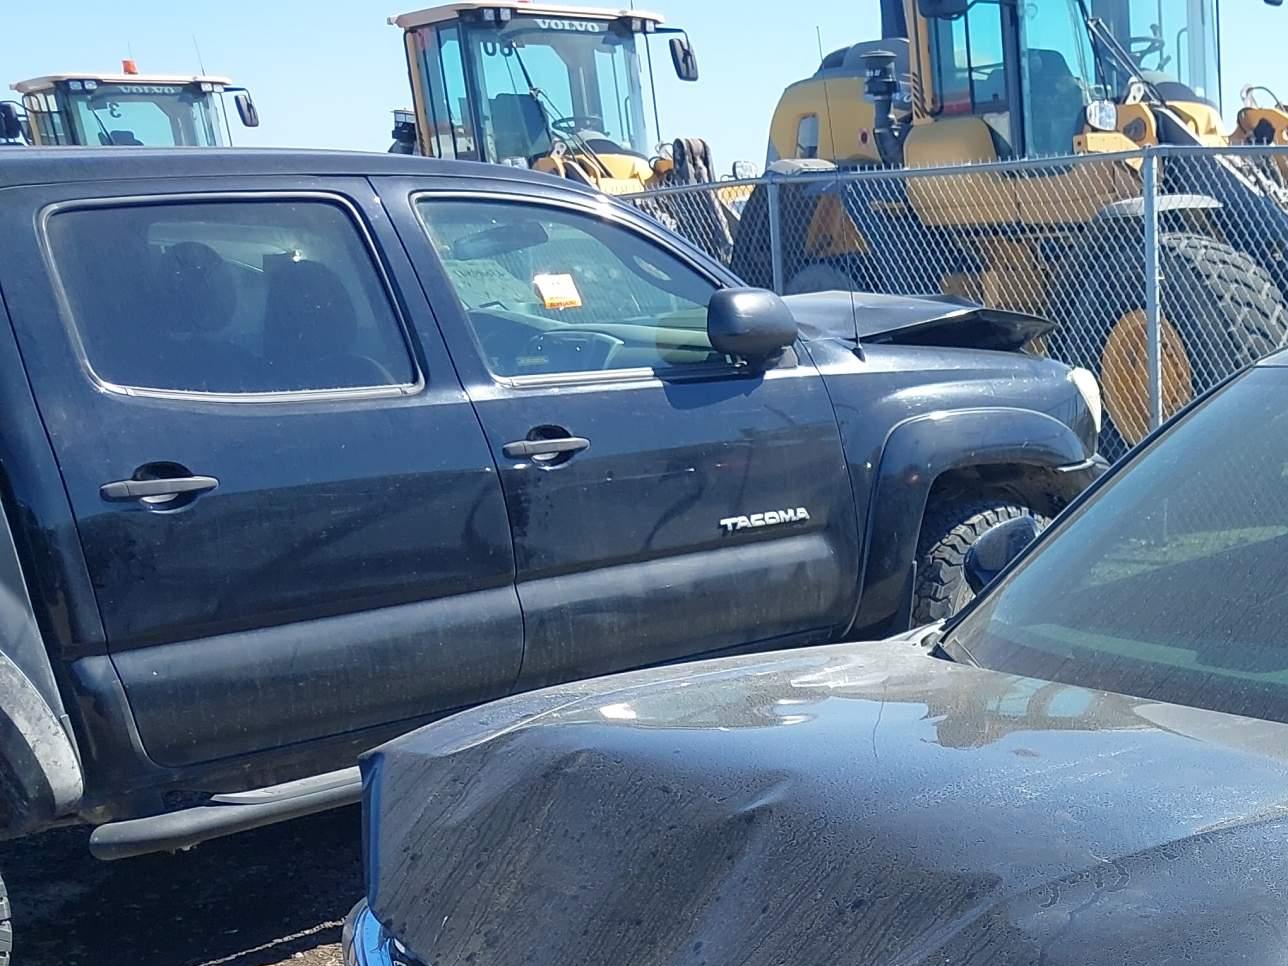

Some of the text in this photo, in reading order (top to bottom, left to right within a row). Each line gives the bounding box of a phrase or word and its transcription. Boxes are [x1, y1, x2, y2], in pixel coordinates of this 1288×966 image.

[534, 19, 600, 32] VOLVO
[119, 85, 176, 94] VOLVO
[720, 507, 810, 531] TACOMA
